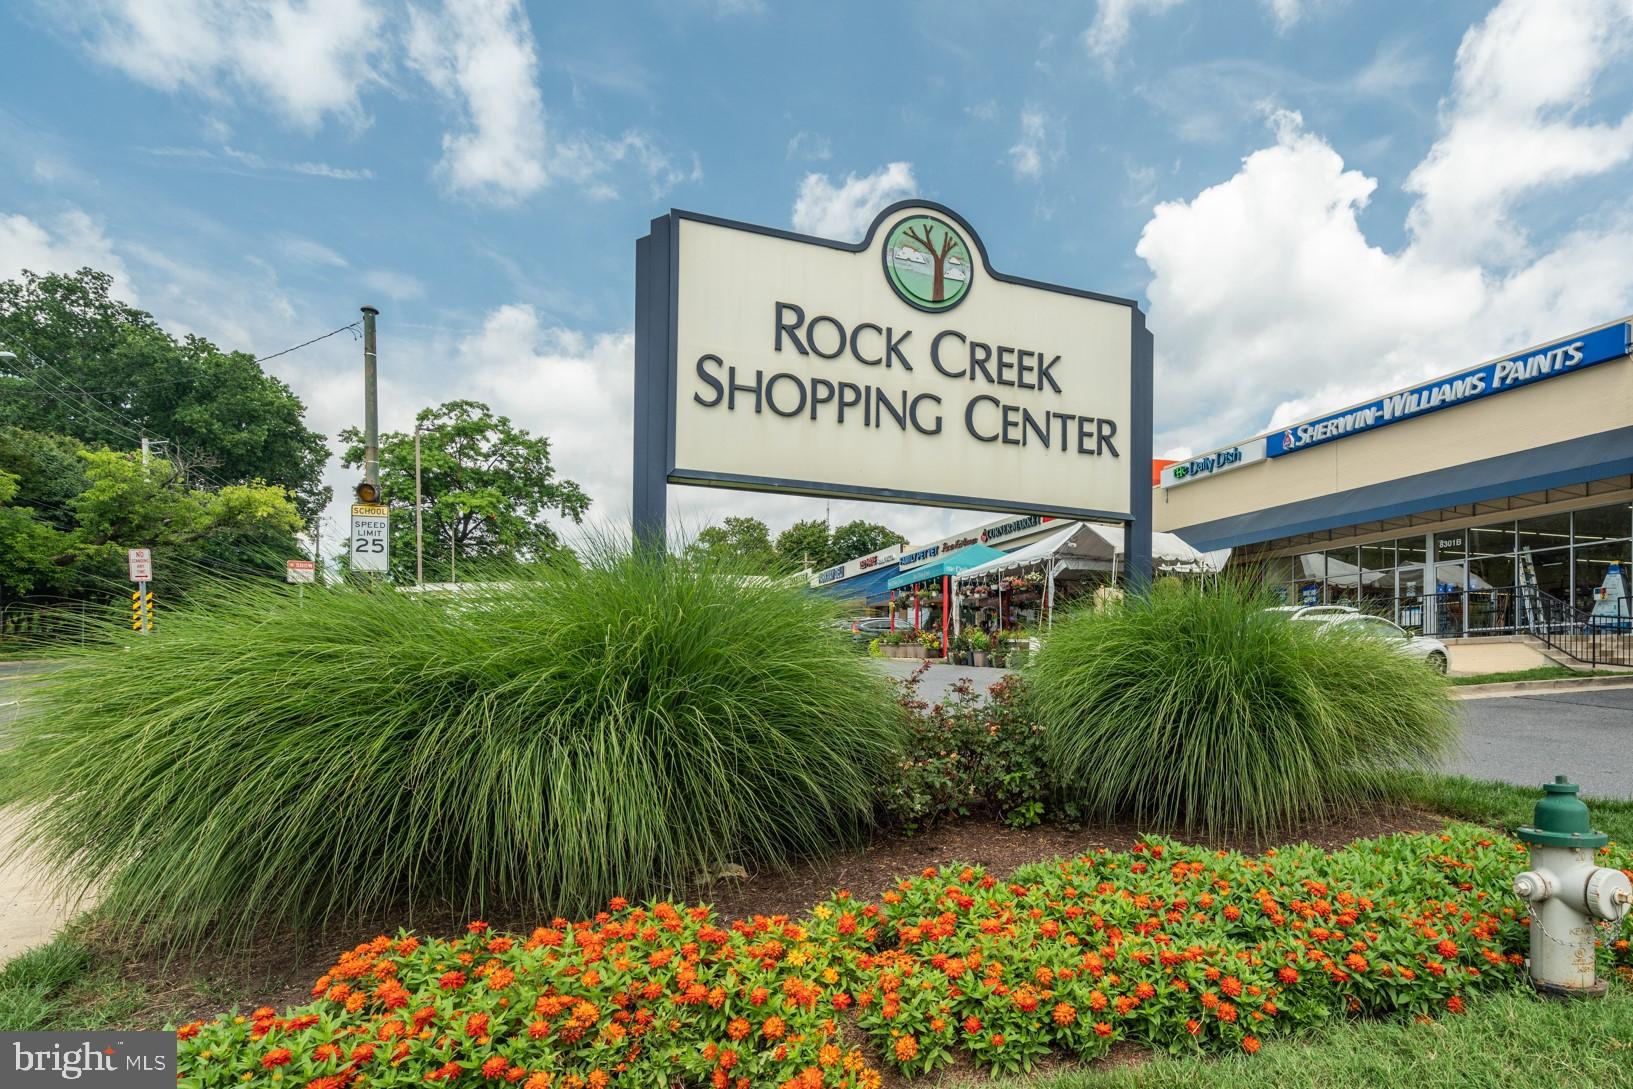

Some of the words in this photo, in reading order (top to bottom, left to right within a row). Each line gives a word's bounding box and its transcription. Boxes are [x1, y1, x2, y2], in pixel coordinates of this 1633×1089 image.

[774, 300, 914, 371] ROCK
[929, 329, 1062, 393] CREEK
[1295, 372, 1486, 447] SHERWIN-WILLIAMS
[1492, 341, 1585, 388] PAINTS
[693, 353, 943, 435] SHOPPING
[964, 394, 1120, 457] CENTER
[1189, 456, 1215, 476] Daily
[1216, 447, 1242, 468] Dish
[353, 507, 387, 515] SCHOOL
[354, 520, 386, 529] SPEED
[357, 529, 383, 537] LIMIT
[355, 538, 385, 553] 25
[1439, 538, 1462, 548] 8301B
